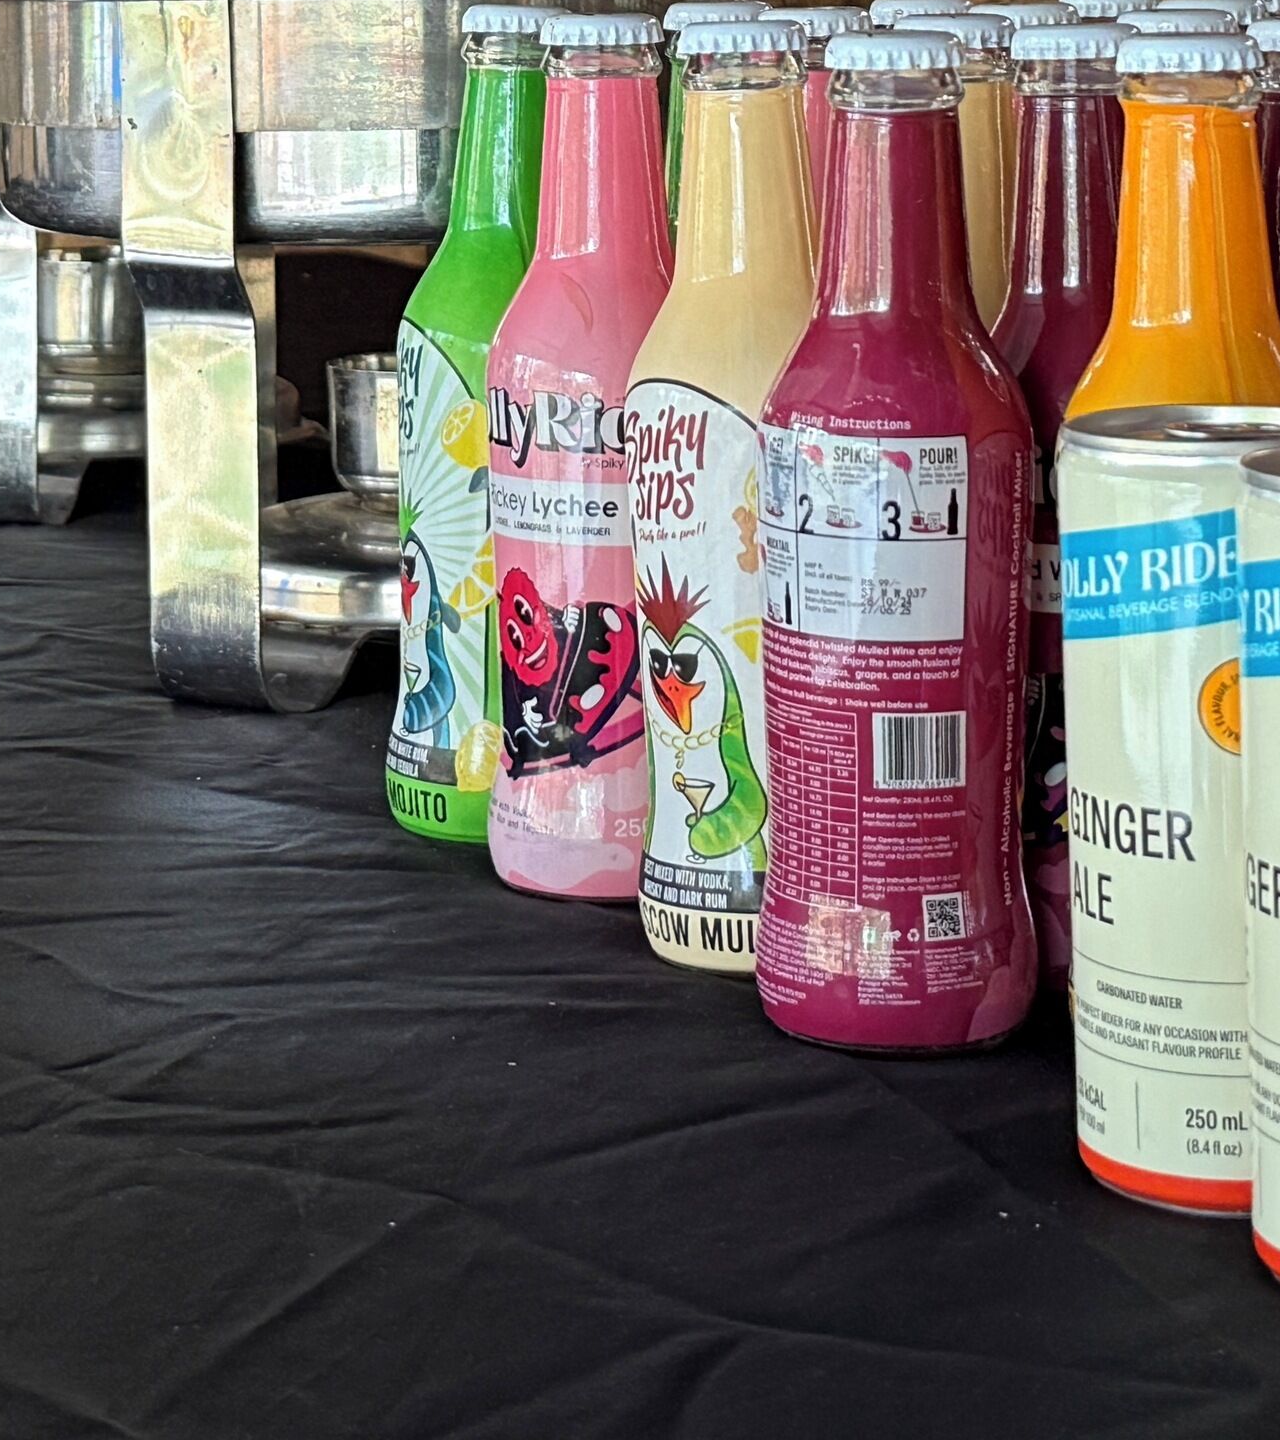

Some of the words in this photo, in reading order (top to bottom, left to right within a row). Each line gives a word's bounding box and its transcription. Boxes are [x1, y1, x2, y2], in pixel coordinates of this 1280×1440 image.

[829, 414, 911, 431] Instructions
[625, 404, 708, 484] Spiky
[920, 446, 958, 465] POUR!
[595, 459, 625, 470] Spiky
[1013, 451, 1021, 497] Mixer
[532, 491, 619, 519] Lychee
[799, 494, 814, 534] 2
[566, 525, 610, 536] LAVENDER
[882, 500, 901, 540] 3
[1011, 503, 1021, 575] Cocktail
[1062, 550, 1128, 598] OLLY
[1140, 536, 1237, 592] RIDE
[1108, 596, 1178, 620] BEVERAGE
[1007, 582, 1018, 672] SIGNATURE
[789, 636, 819, 649] splendid
[858, 645, 889, 655] Mulled
[892, 647, 915, 655] Wine
[918, 646, 936, 655] and
[939, 645, 963, 656] enjoy
[808, 651, 838, 664] delight.
[842, 656, 867, 667] Enjoy
[869, 657, 884, 666] the
[887, 658, 920, 668] smooth
[923, 658, 949, 667] fusion
[952, 656, 960, 666] of
[826, 680, 880, 691] celebration.
[855, 670, 889, 680] grapes,
[892, 671, 911, 680] and
[923, 670, 949, 680] touch
[951, 668, 960, 678] of
[845, 697, 869, 708] Shake
[870, 700, 886, 709] well
[887, 700, 913, 709] before
[915, 701, 928, 709] use
[1004, 692, 1014, 771] Beverage
[387, 777, 447, 823] MOJITO
[1001, 776, 1012, 852] Alcoholic
[1070, 786, 1196, 862] GINGER
[654, 862, 674, 882] MIXED
[675, 867, 697, 887] WITH
[699, 872, 733, 893] VODKA,
[1004, 869, 1012, 905] Non
[663, 886, 678, 903] AND
[680, 889, 703, 907] DARK
[705, 892, 727, 910] RUM
[1073, 860, 1115, 925] ALE
[642, 900, 690, 948] SCOW
[1096, 980, 1147, 1004] CARBONATED
[1149, 993, 1183, 1009] WATER
[1109, 1030, 1150, 1052] PLEASANT
[1152, 1040, 1197, 1058] FLAVOUR
[1199, 1046, 1241, 1060] PROFILE
[1125, 1018, 1141, 1032] FOR
[1143, 1022, 1163, 1037] ANY
[1164, 1025, 1217, 1042] OCCASION
[1220, 1030, 1248, 1043] WITH
[1186, 1108, 1217, 1130] 250
[1222, 1111, 1248, 1131] mL
[1187, 1138, 1210, 1154] (8.4
[1213, 1139, 1222, 1155] fl
[1224, 1141, 1243, 1158] oz)
